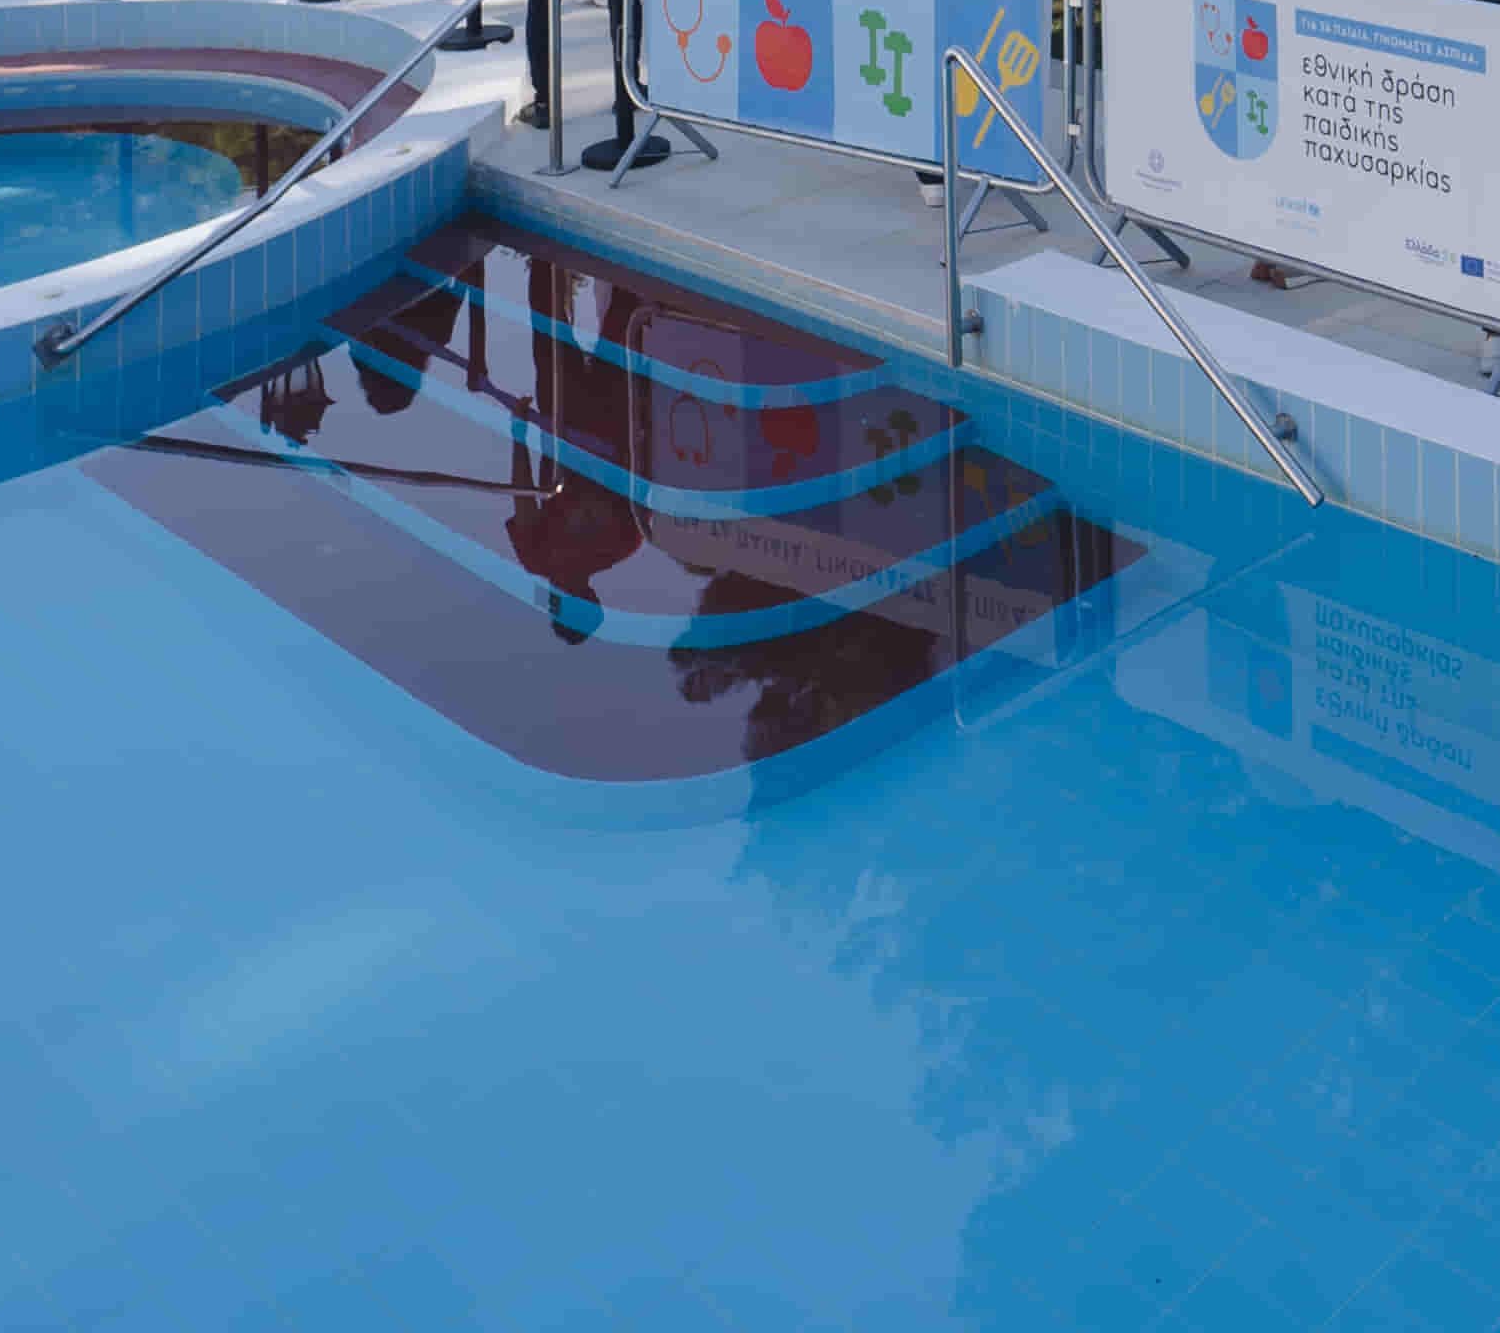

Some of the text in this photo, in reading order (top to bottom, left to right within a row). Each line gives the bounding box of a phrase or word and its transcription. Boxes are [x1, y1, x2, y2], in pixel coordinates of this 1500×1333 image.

[1302, 53, 1456, 108] εθνική δράση
[1303, 85, 1404, 124] κατά της
[1304, 113, 1399, 152] παιδικής
[1304, 139, 1451, 193] παχυσαρκίας
